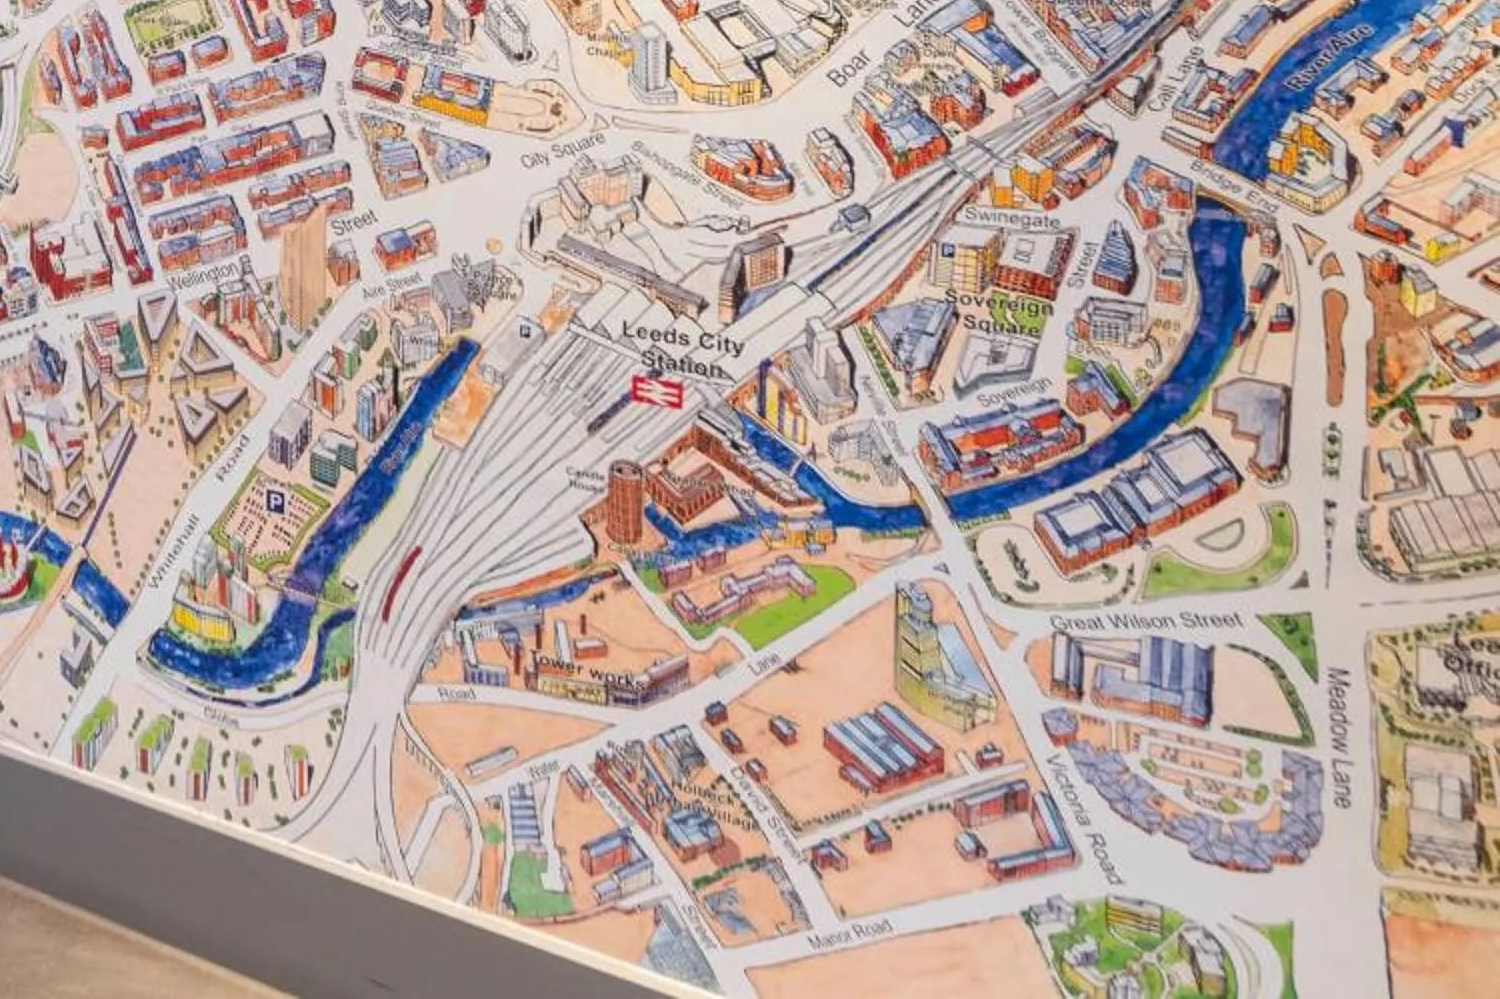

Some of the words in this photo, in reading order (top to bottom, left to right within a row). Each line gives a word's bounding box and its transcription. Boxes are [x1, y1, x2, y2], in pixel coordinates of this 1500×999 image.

[827, 47, 873, 90] Boar
[1285, 49, 1332, 92] River
[1330, 22, 1378, 55] Aire
[1148, 83, 1177, 113] Call
[1173, 46, 1204, 87] Lane
[520, 149, 551, 171] City
[551, 133, 606, 159] Square
[1189, 159, 1243, 198] Bridge
[1247, 189, 1280, 215] End
[964, 206, 1062, 231] Swinegate
[166, 260, 240, 293] Wellington
[330, 208, 379, 237] Street
[945, 288, 1055, 318] Sovereign
[621, 320, 692, 348] Leeds
[698, 331, 747, 357] City
[963, 313, 1042, 338] Square
[976, 377, 1055, 407] Sovereign
[1067, 240, 1100, 292] Street
[640, 348, 726, 379] Station
[214, 433, 251, 484] Road
[1051, 613, 1104, 632] Great
[1111, 612, 1177, 631] Wilson
[1180, 611, 1245, 629] Street
[531, 649, 585, 678] Tower
[748, 651, 783, 679] Lane
[1328, 666, 1353, 757] Meadow
[1328, 758, 1353, 811] Lane
[1045, 751, 1092, 830] Victoria
[1085, 831, 1126, 888] Road
[852, 919, 895, 944] Road
